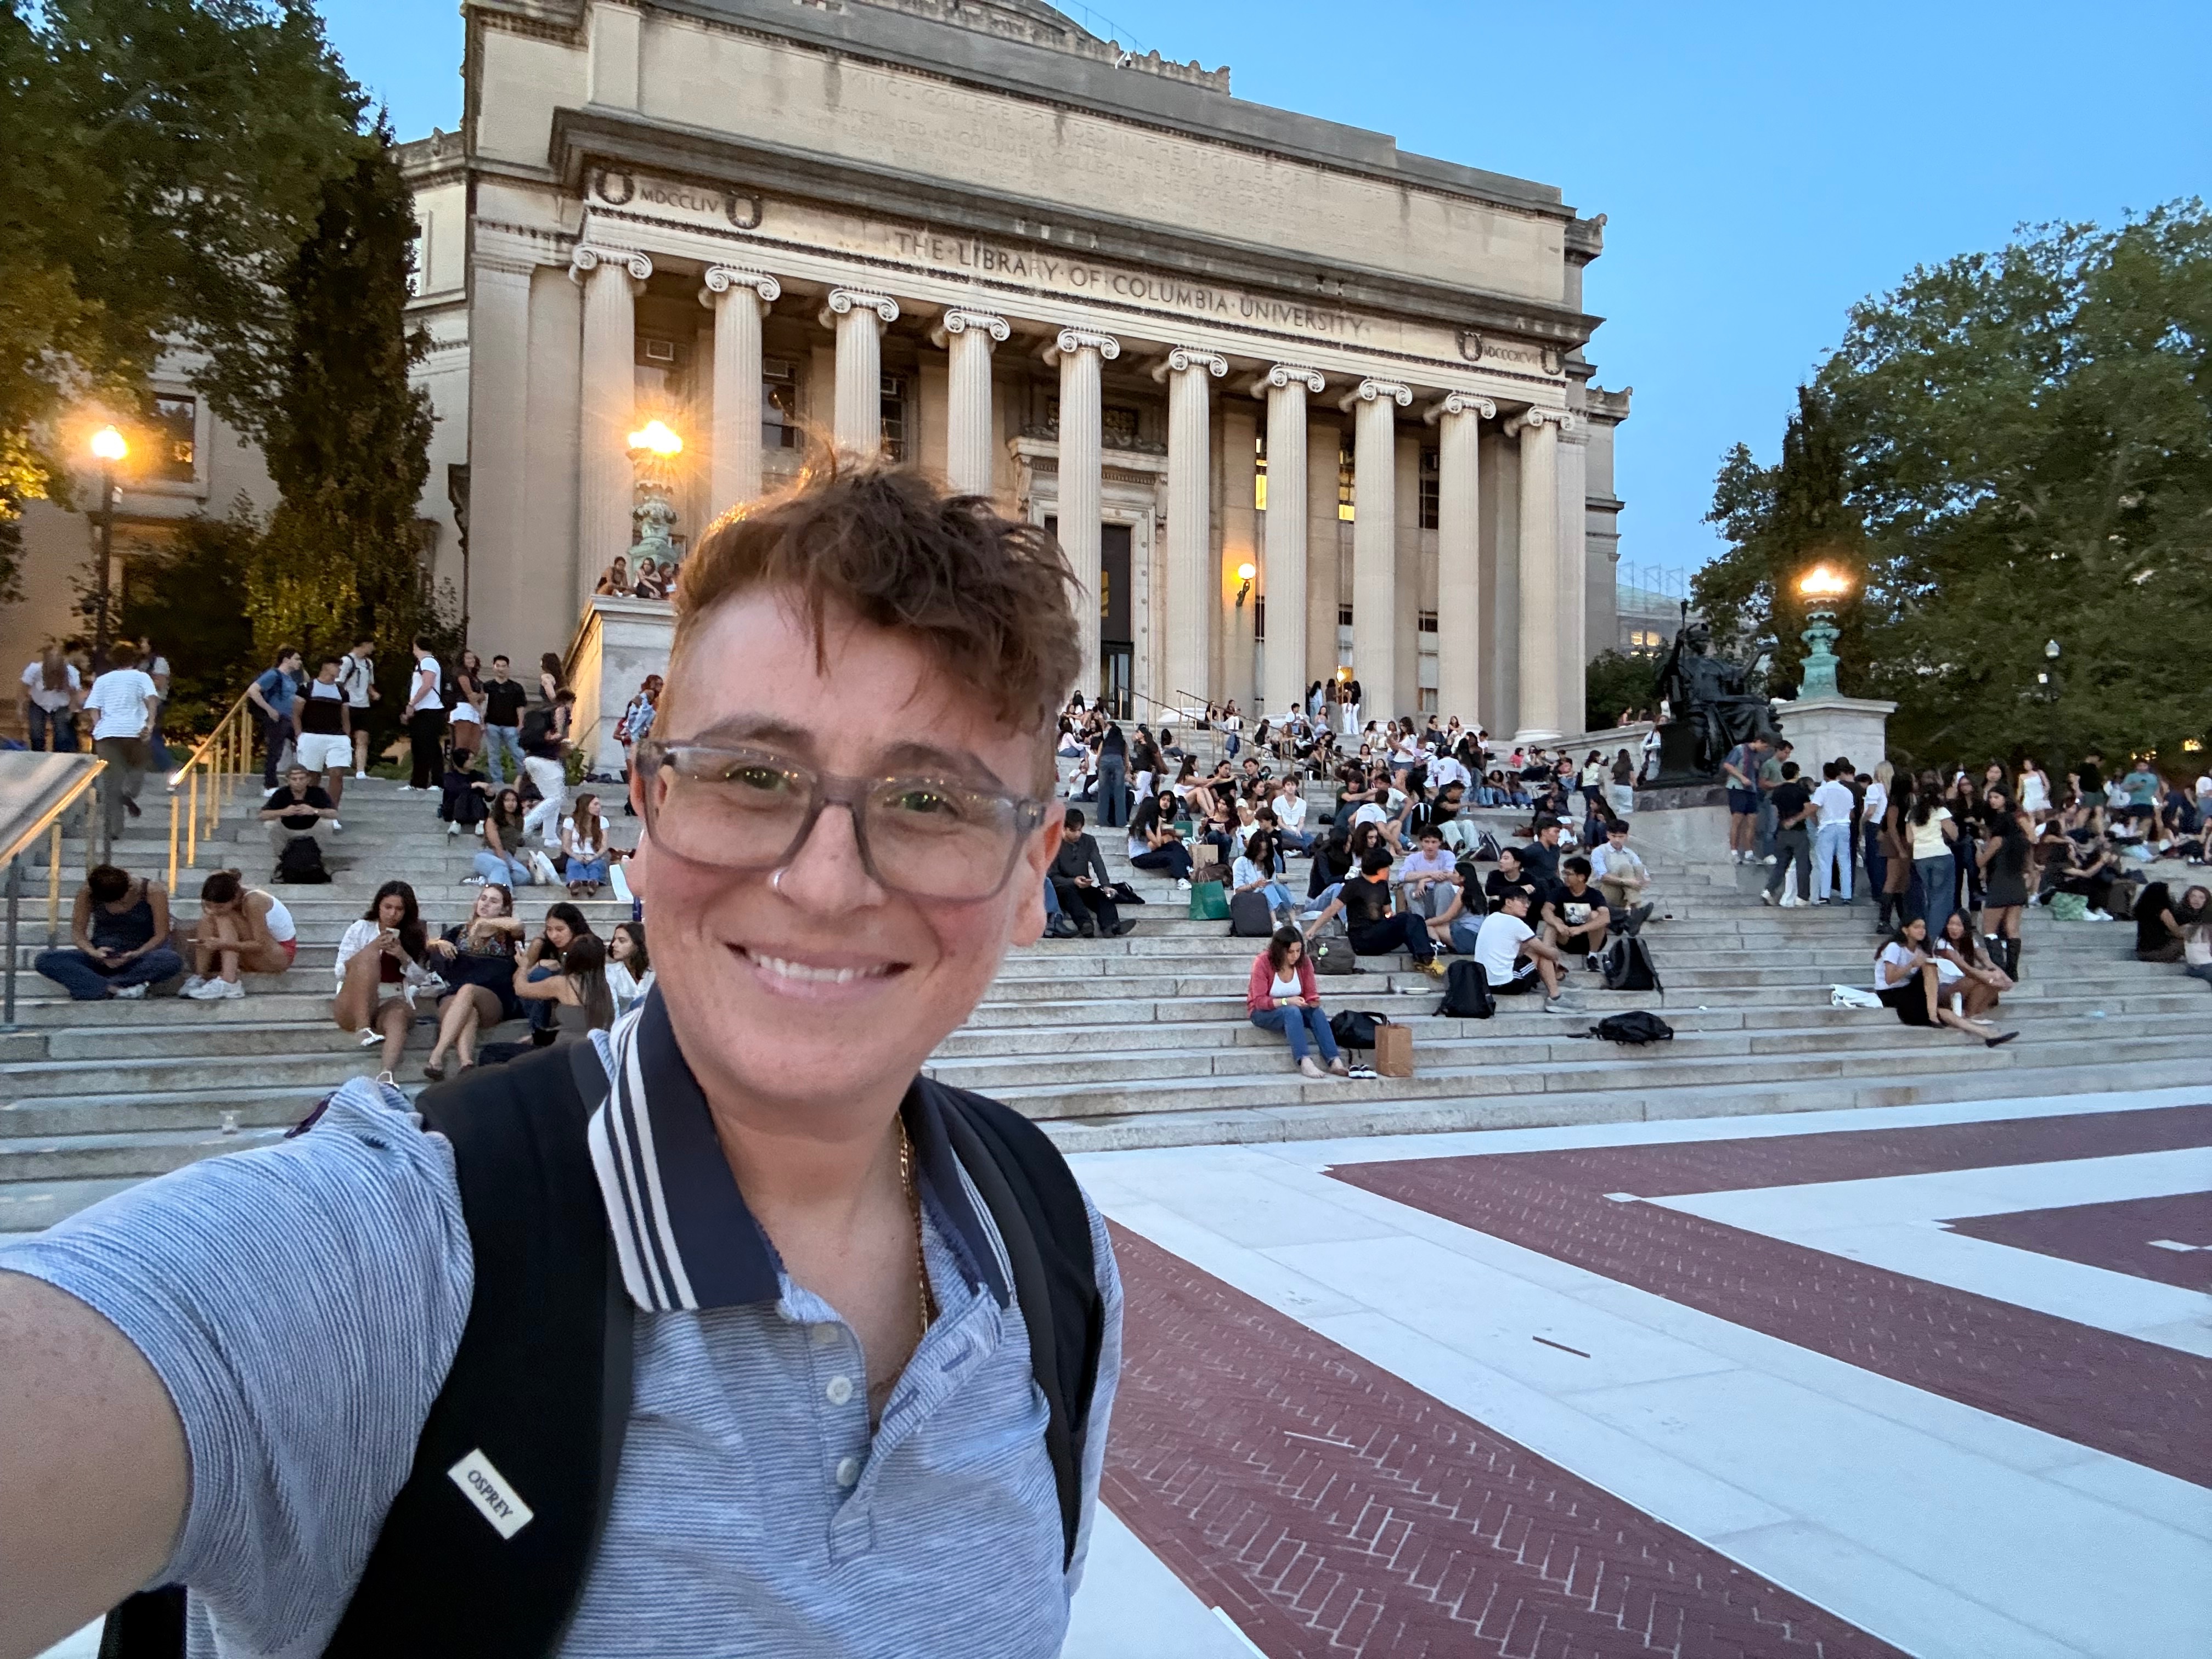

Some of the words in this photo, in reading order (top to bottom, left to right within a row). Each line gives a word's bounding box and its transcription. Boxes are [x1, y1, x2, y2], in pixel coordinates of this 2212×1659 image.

[640, 188, 719, 213] MDCCLIV
[894, 232, 943, 260] THE
[958, 241, 1059, 281] LIBRARY
[1070, 267, 1101, 290] OF
[1113, 275, 1229, 314] COLUMBIA
[1240, 297, 1363, 337] UNIVERSITY
[467, 1470, 514, 1520] OSPREY
